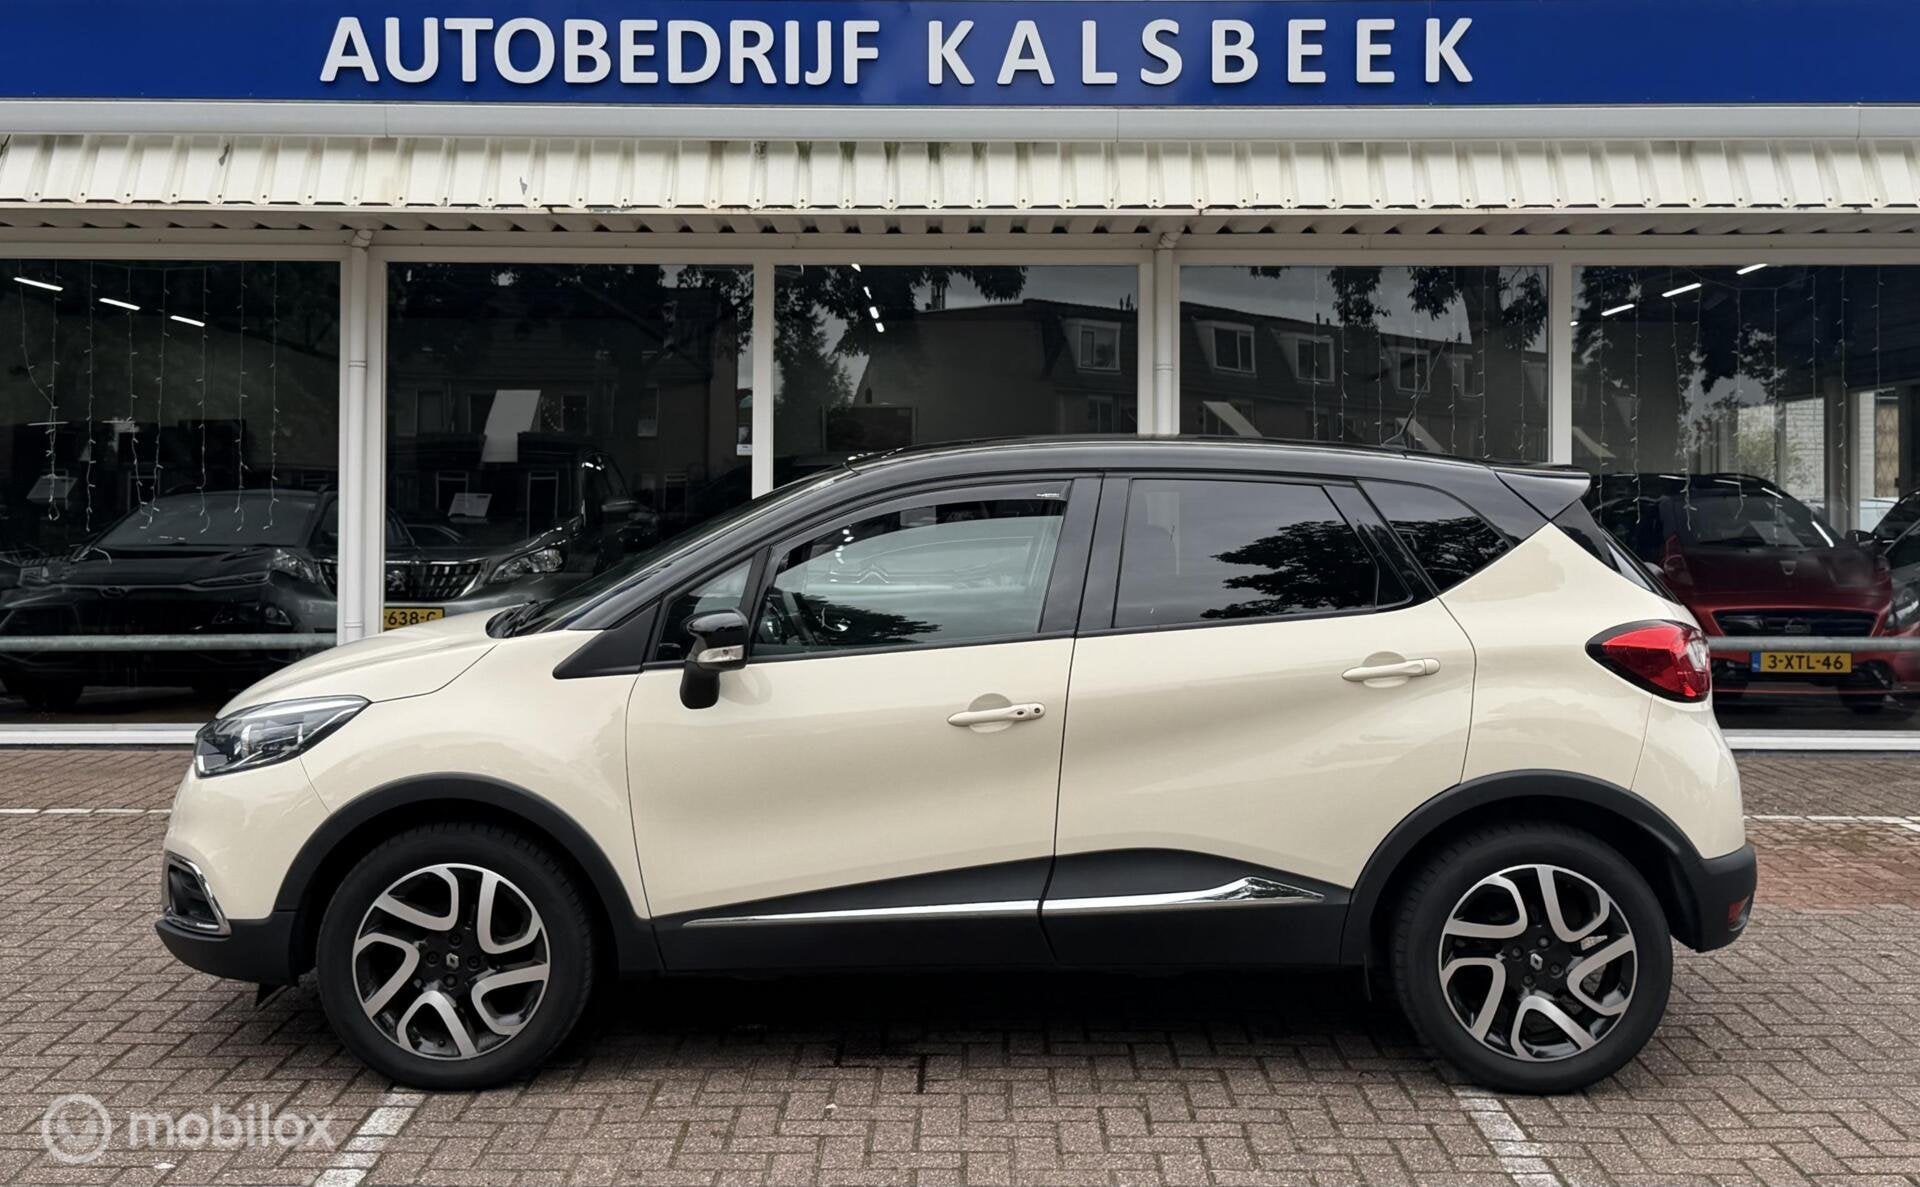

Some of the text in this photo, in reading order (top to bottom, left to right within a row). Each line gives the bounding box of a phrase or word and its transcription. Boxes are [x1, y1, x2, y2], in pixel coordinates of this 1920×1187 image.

[320, 17, 1473, 85] AUTOBEDRIJF KALSBEEK
[1768, 654, 1844, 670] 3-XTL-46
